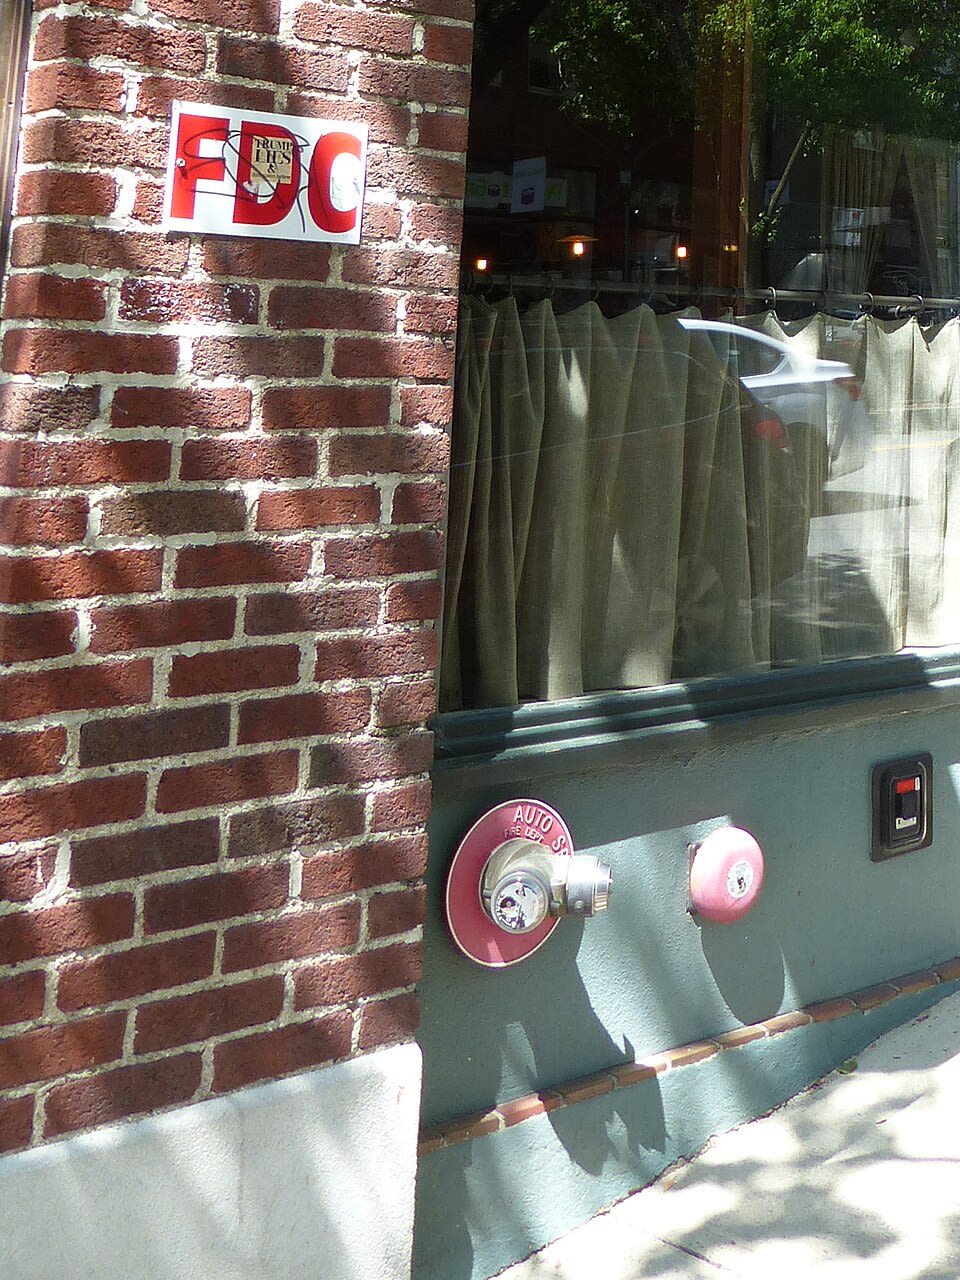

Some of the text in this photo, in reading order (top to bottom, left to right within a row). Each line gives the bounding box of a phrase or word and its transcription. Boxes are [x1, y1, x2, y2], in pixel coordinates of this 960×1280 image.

[254, 138, 293, 151] TRUMP
[255, 149, 291, 165] LIES
[170, 112, 362, 234] FDC
[513, 805, 553, 833] AUTO
[504, 825, 522, 838] FIRE
